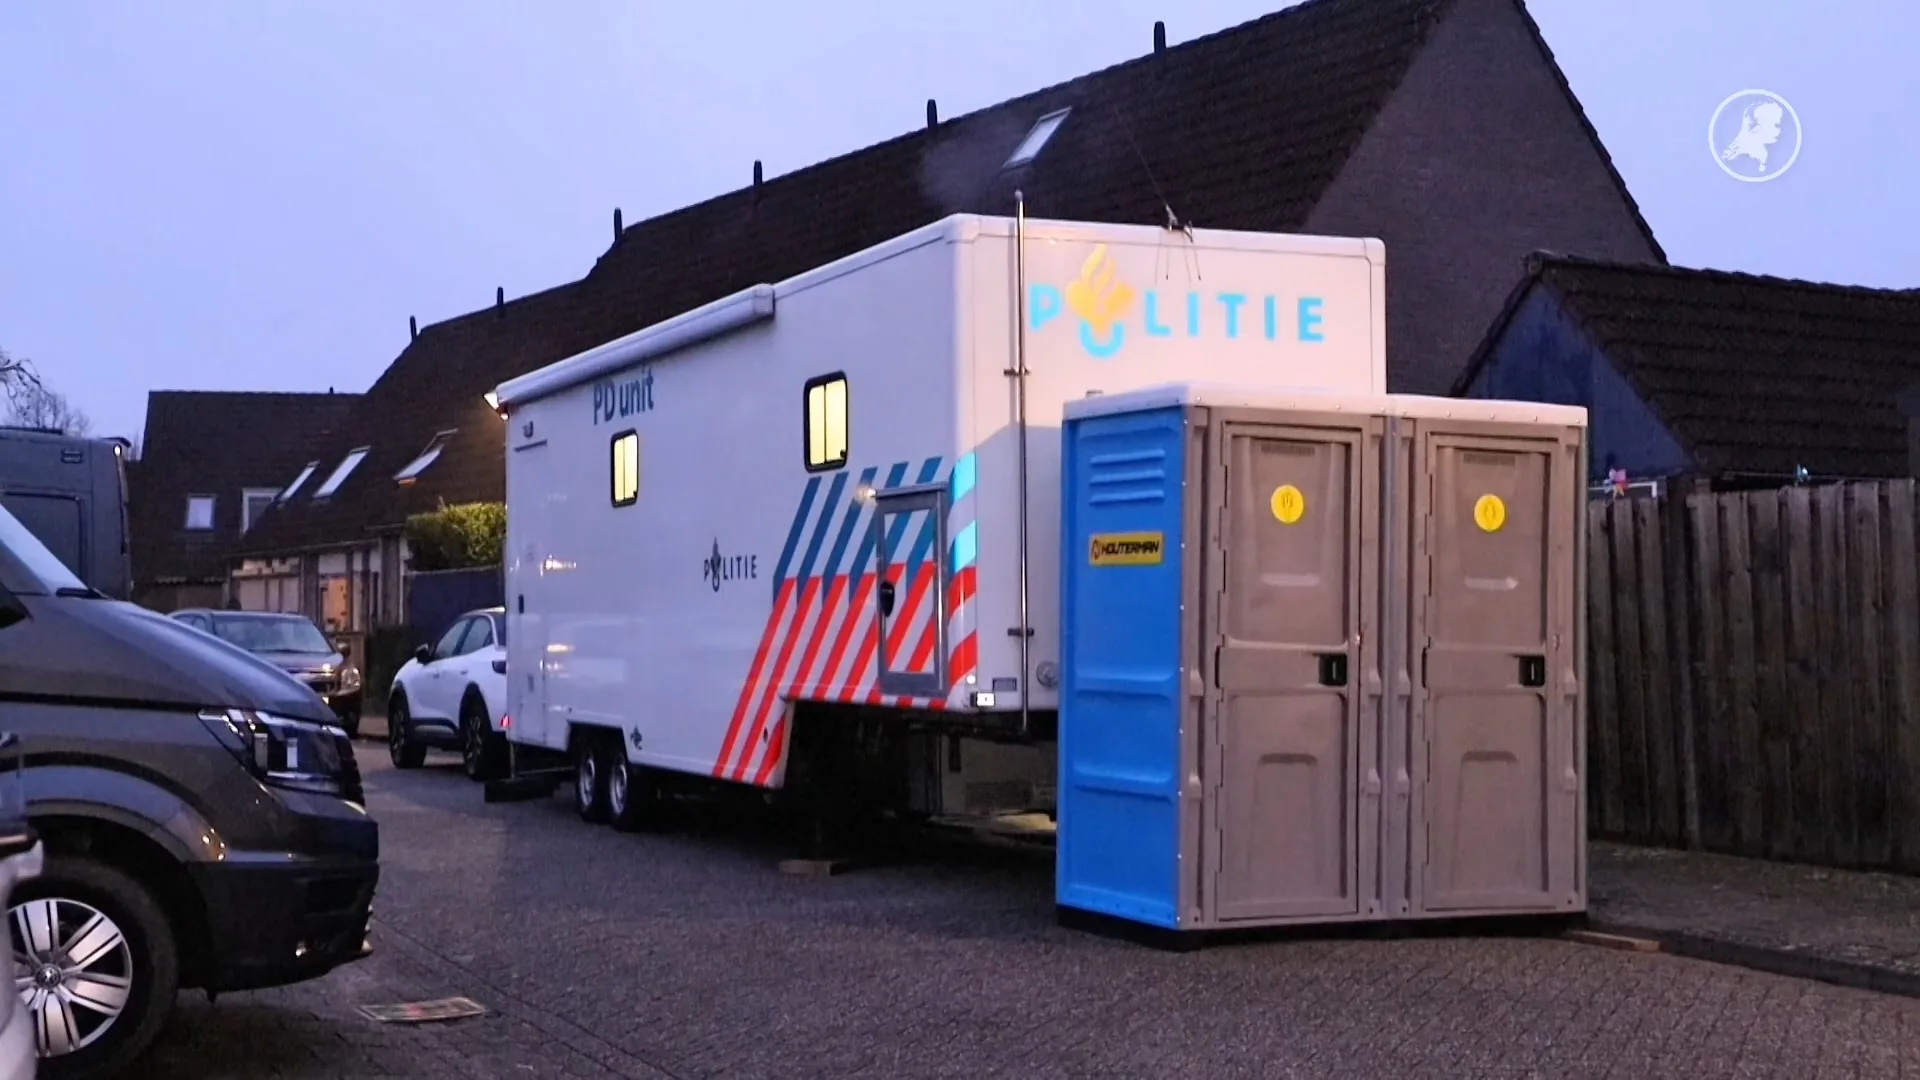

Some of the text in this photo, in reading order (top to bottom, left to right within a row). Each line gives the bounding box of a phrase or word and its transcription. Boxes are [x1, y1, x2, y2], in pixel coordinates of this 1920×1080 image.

[1028, 282, 1325, 359] POLITIE
[593, 366, 654, 425] PD unit
[703, 554, 757, 592] POLITIE
